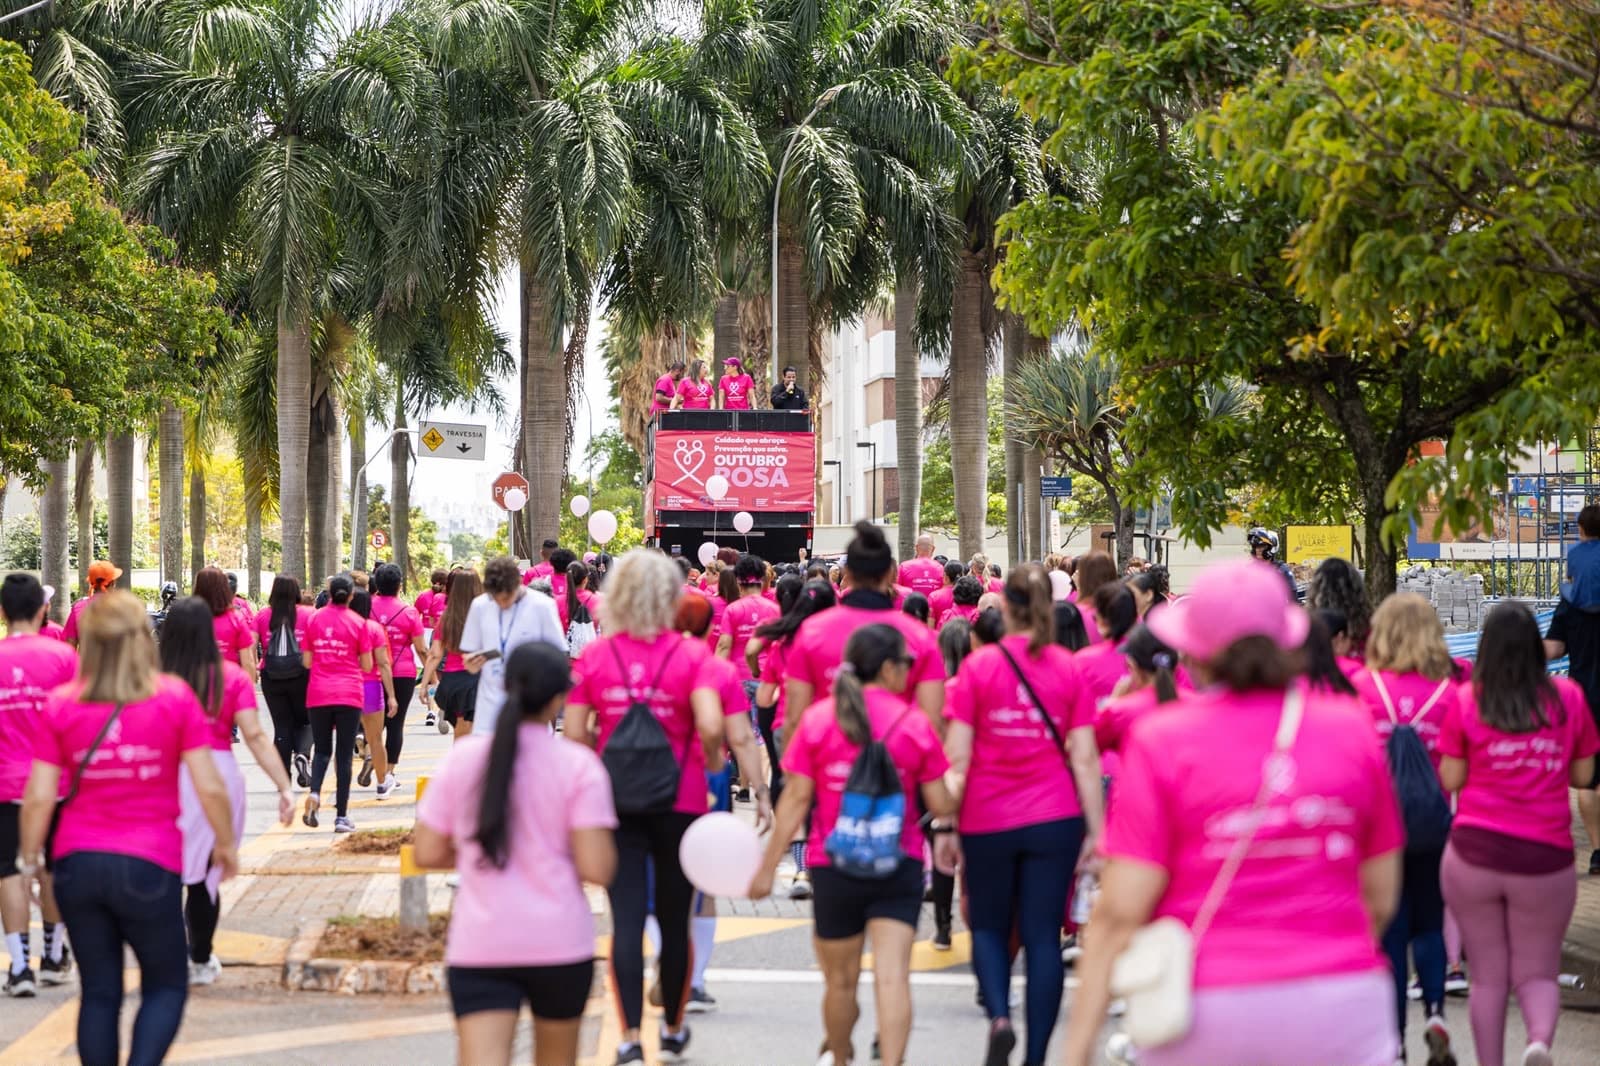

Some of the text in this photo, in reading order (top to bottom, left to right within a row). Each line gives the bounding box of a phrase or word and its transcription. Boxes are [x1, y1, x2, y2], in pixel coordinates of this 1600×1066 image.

[446, 430, 483, 438] TRAVESSIA
[759, 436, 787, 445] abraça.
[714, 445, 752, 453] Prevenção
[714, 455, 787, 466] OUTUBRO
